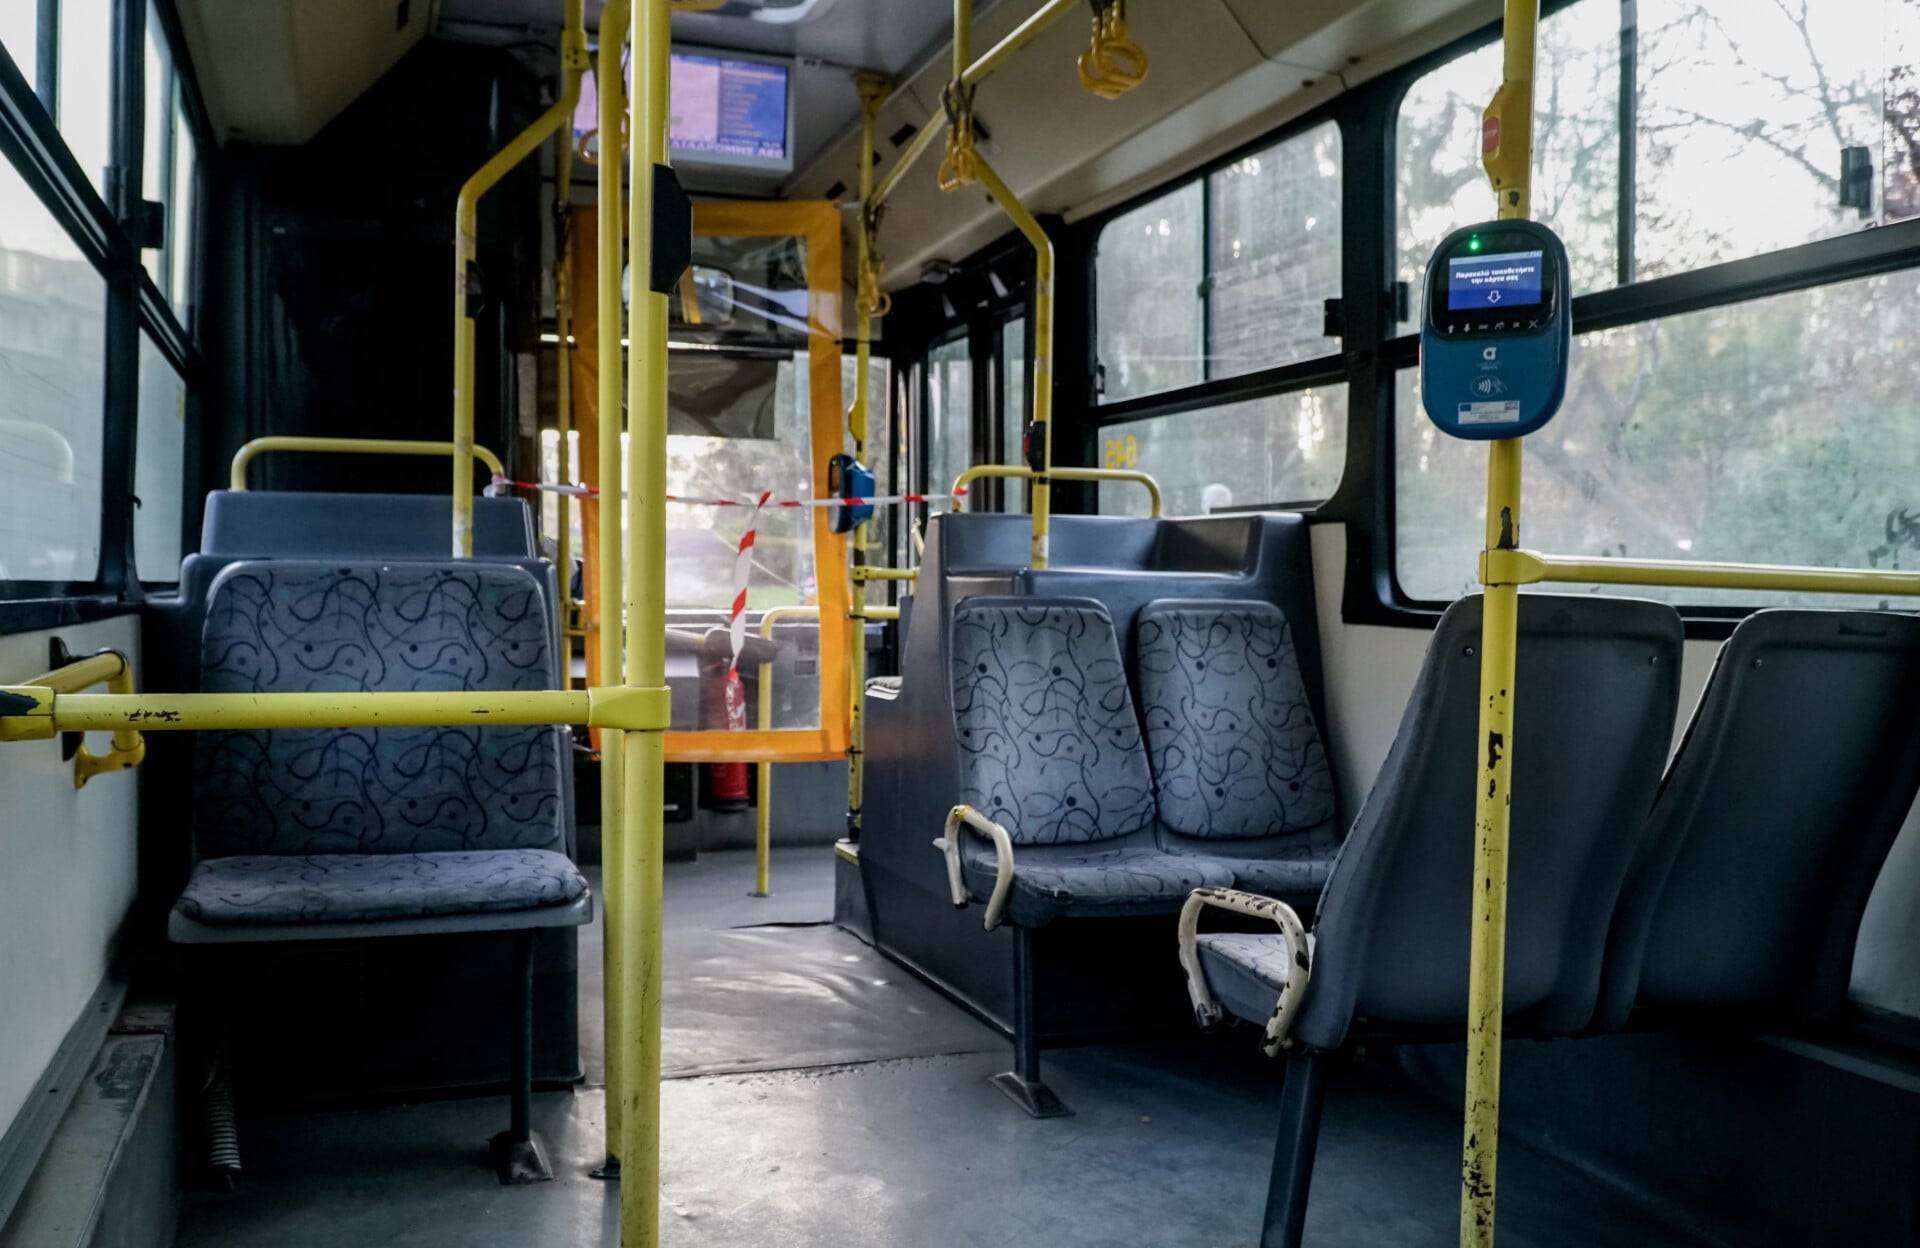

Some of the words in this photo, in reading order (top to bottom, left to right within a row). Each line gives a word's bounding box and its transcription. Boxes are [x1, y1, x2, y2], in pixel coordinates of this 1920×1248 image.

[1456, 269, 1490, 279] Παρακαλώ
[1491, 266, 1534, 275] τοποθετήστε
[1484, 275, 1504, 283] κάρτα
